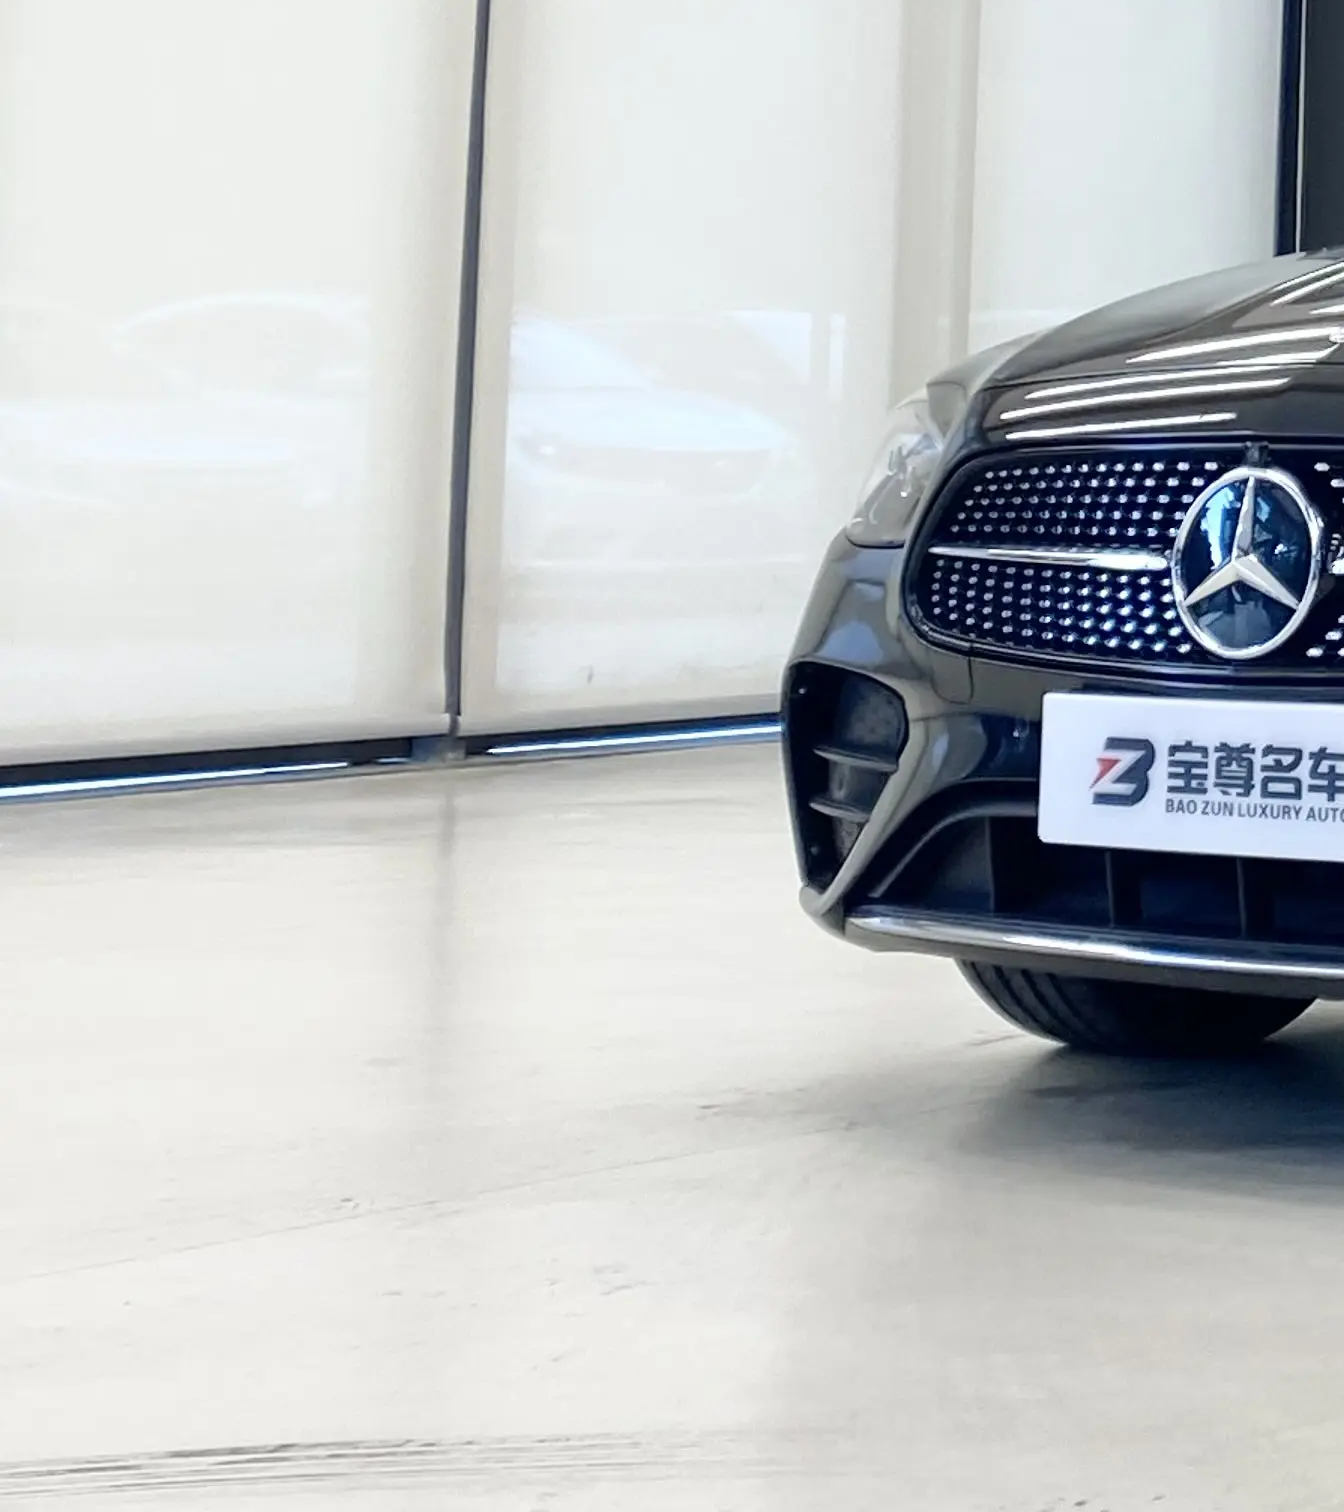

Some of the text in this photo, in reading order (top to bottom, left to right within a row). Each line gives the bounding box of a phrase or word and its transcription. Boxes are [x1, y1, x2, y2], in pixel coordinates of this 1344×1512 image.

[1165, 798, 1197, 814] BAO
[1200, 800, 1234, 817] ZUN
[1237, 801, 1302, 821] LUXURY
